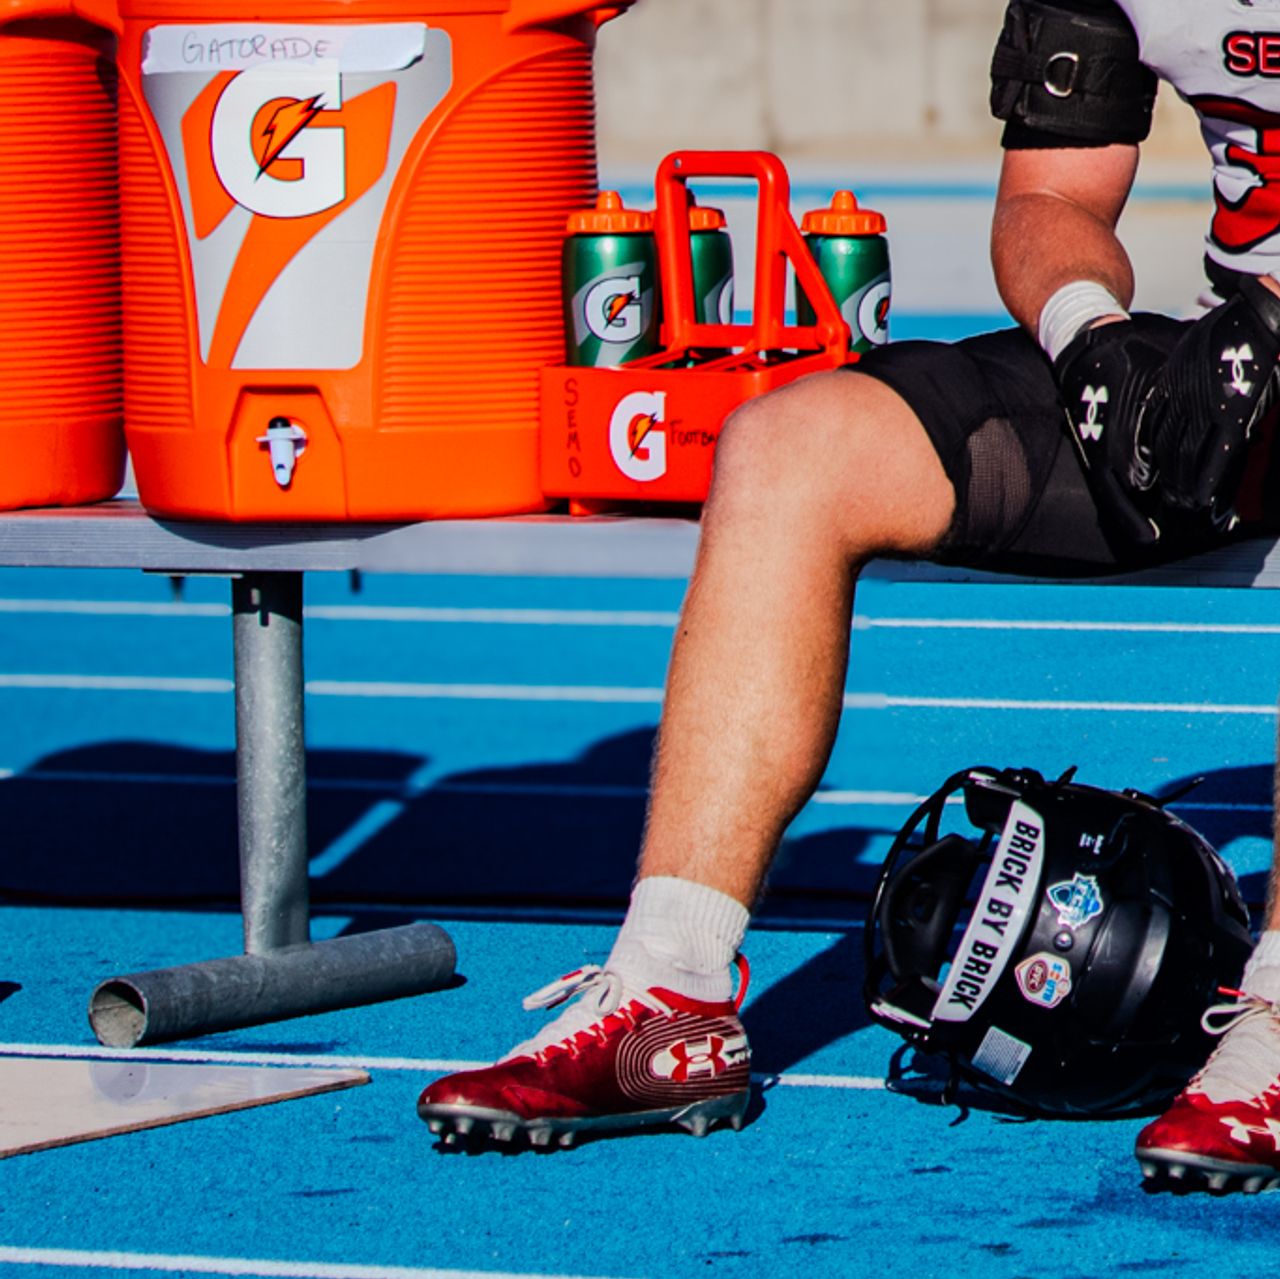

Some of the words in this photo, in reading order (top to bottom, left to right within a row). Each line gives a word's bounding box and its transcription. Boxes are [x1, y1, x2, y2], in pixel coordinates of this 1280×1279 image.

[181, 32, 332, 64] GATORADE
[210, 57, 346, 220] G
[585, 275, 642, 343] G
[564, 377, 582, 478] SEMO
[609, 391, 666, 482] G
[995, 820, 1040, 894] BRICK
[981, 897, 1014, 937] BY
[948, 939, 999, 1011] BRICK
